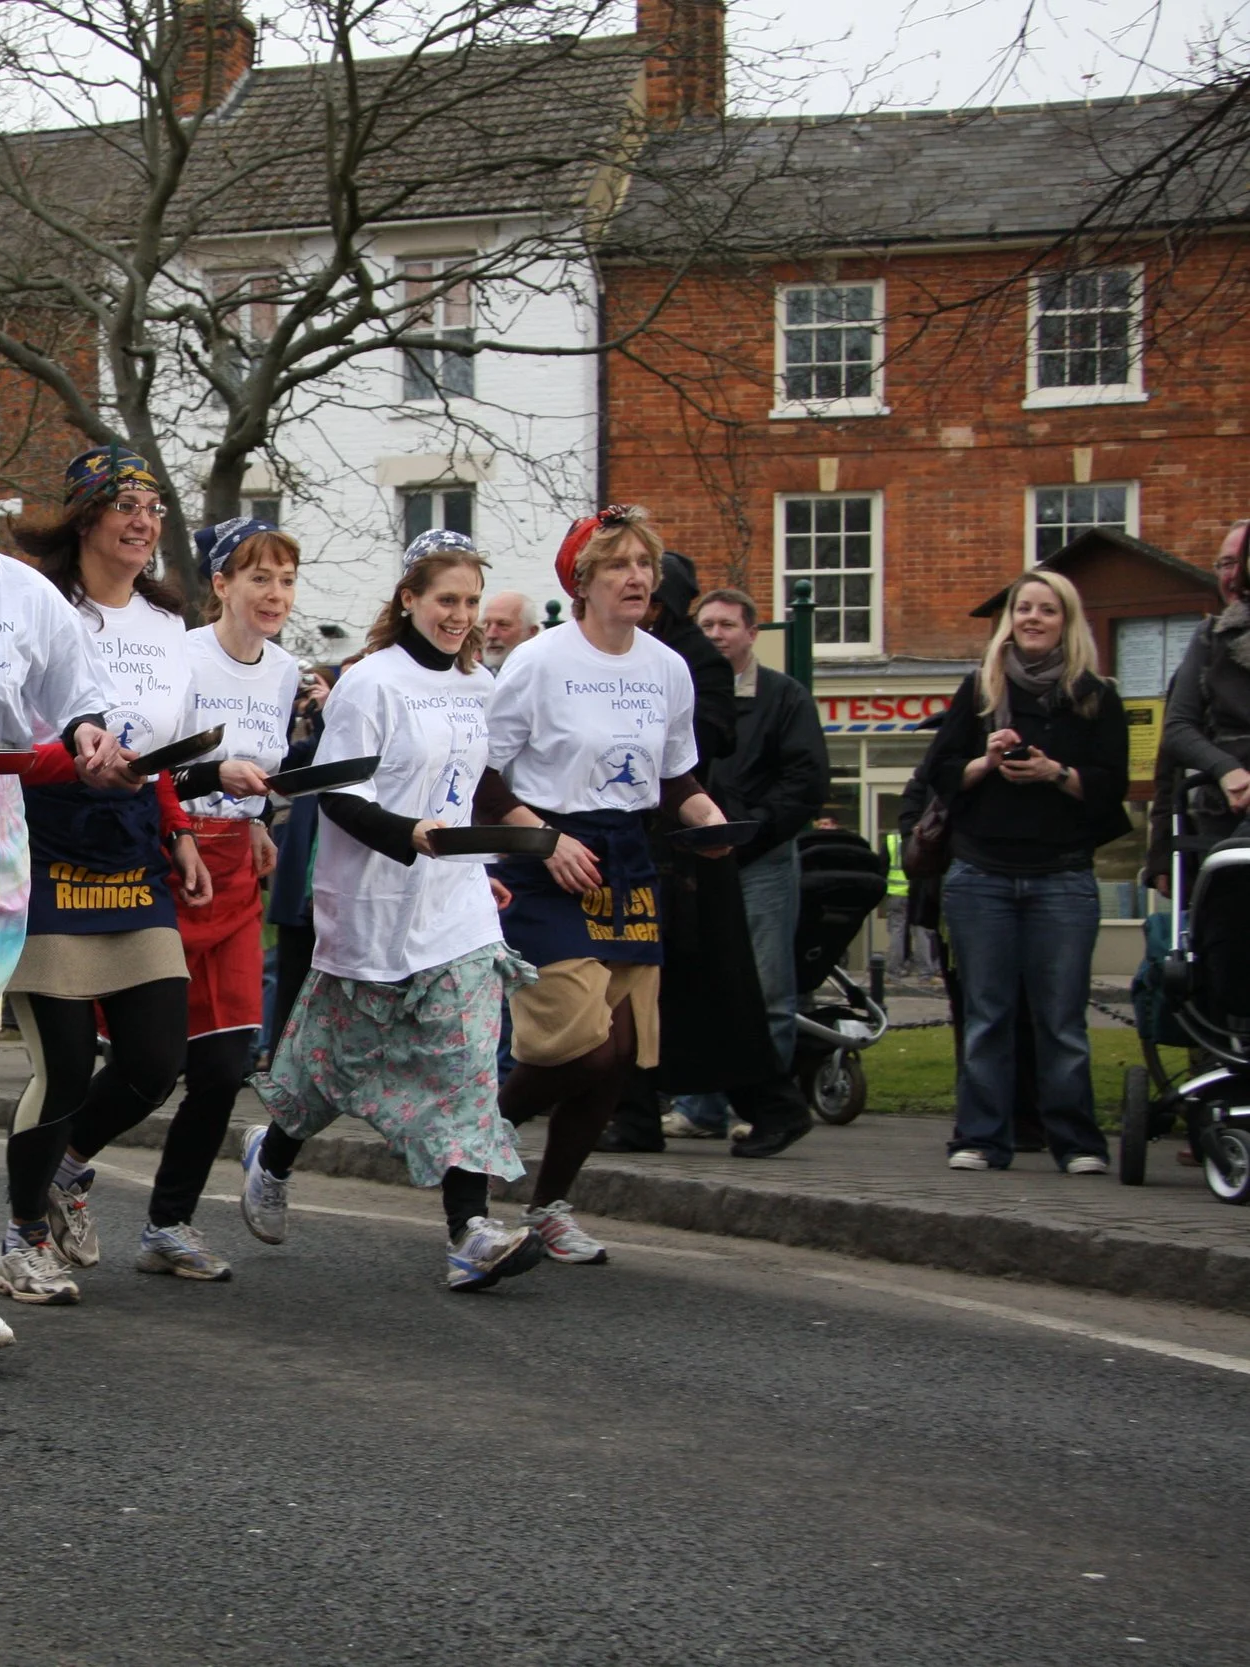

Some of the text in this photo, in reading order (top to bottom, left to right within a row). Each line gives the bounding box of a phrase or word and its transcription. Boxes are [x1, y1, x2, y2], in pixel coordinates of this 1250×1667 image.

[117, 637, 166, 659] JACKSON
[109, 661, 153, 675] HOMES
[135, 675, 171, 696] of Olney
[565, 680, 616, 695] FRANCIS
[194, 693, 282, 718] FRANCIS JACKSO
[404, 695, 447, 710] FRANCIS
[611, 699, 652, 710] HOMES
[818, 695, 952, 721] TESCO
[237, 717, 275, 734] HOMES
[56, 882, 153, 909] Runners
